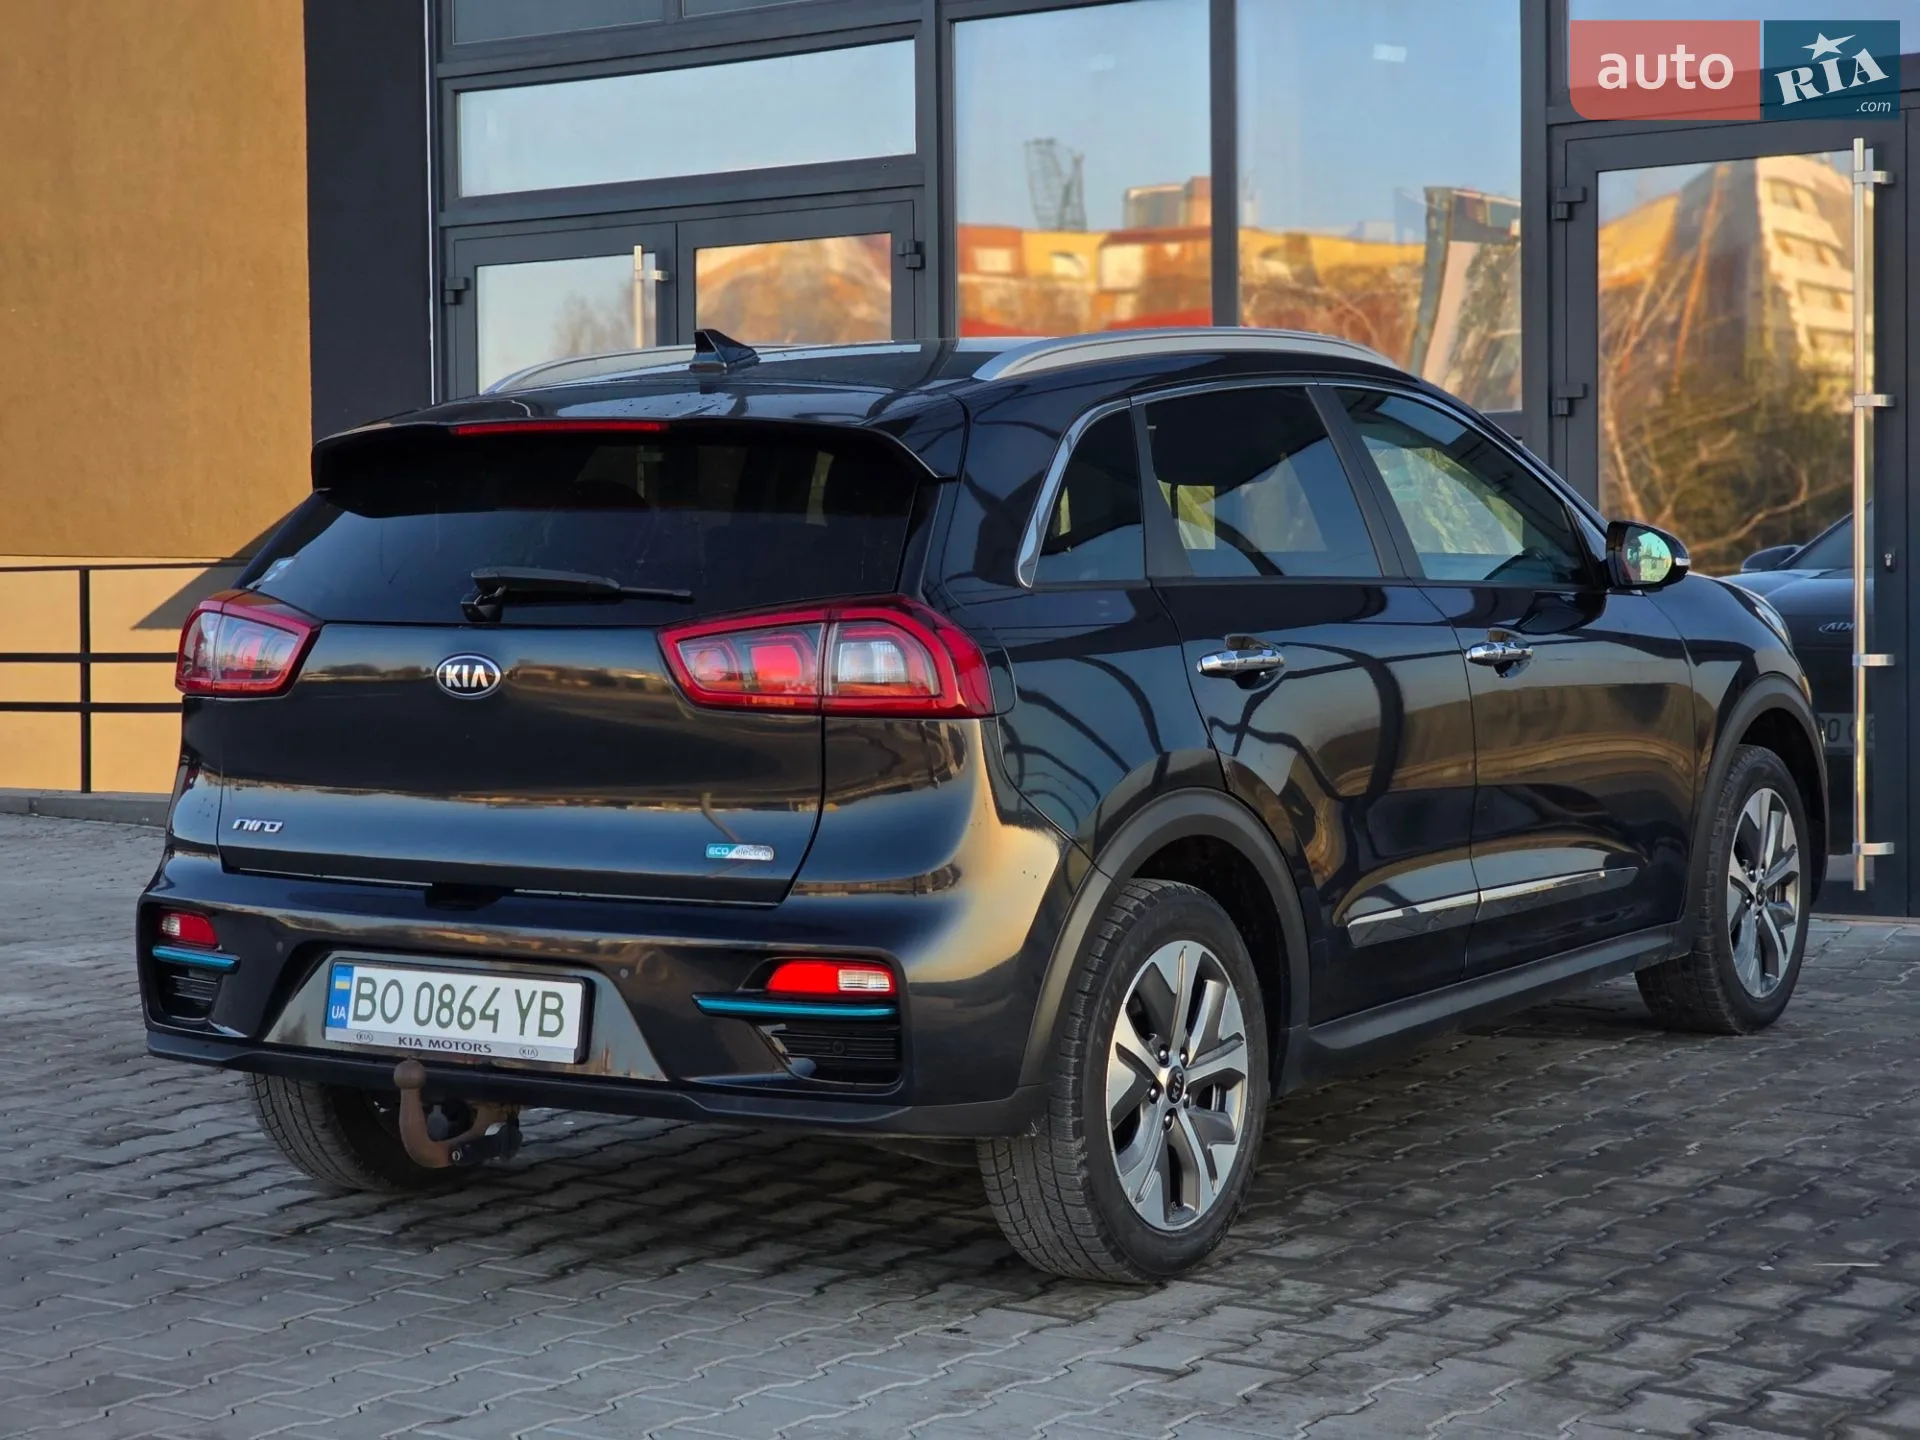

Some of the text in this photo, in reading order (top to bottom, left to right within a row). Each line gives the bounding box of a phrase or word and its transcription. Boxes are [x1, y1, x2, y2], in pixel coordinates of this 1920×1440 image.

[445, 664, 489, 688] KIA
[708, 847, 729, 855] ECO
[331, 1005, 346, 1020] UA
[352, 976, 565, 1037] BO 0864 YB
[398, 1036, 492, 1053] KIA MOTORS
[1171, 1072, 1182, 1100] KIA
